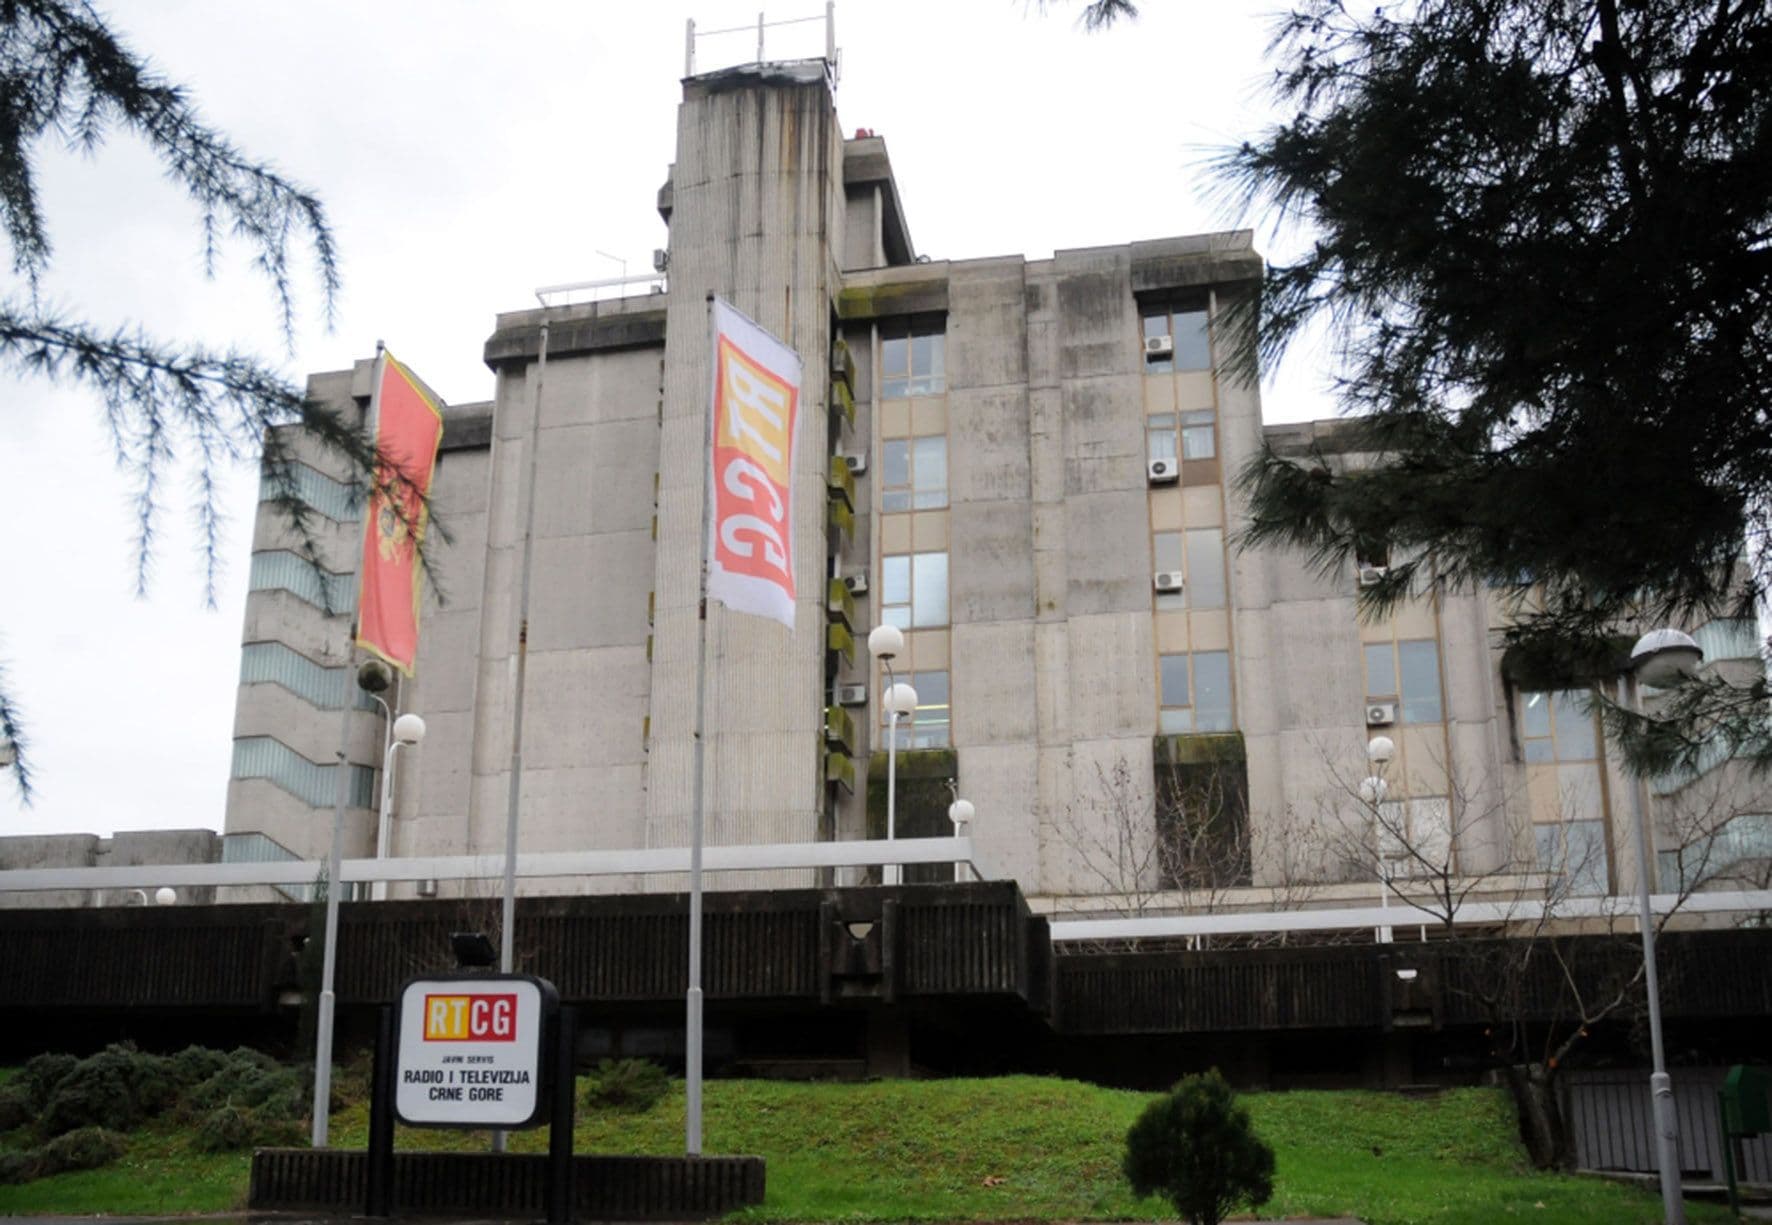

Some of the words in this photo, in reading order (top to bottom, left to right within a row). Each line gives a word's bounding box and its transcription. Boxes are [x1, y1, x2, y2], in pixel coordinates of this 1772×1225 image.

[430, 999, 511, 1036] RTCG
[467, 1056, 494, 1064] SERVIS
[404, 1070, 444, 1084] RADIO
[449, 1070, 453, 1083] I
[460, 1070, 530, 1084] TELEVIZIJA
[429, 1087, 463, 1101] CRNE
[469, 1087, 504, 1101] GORE
